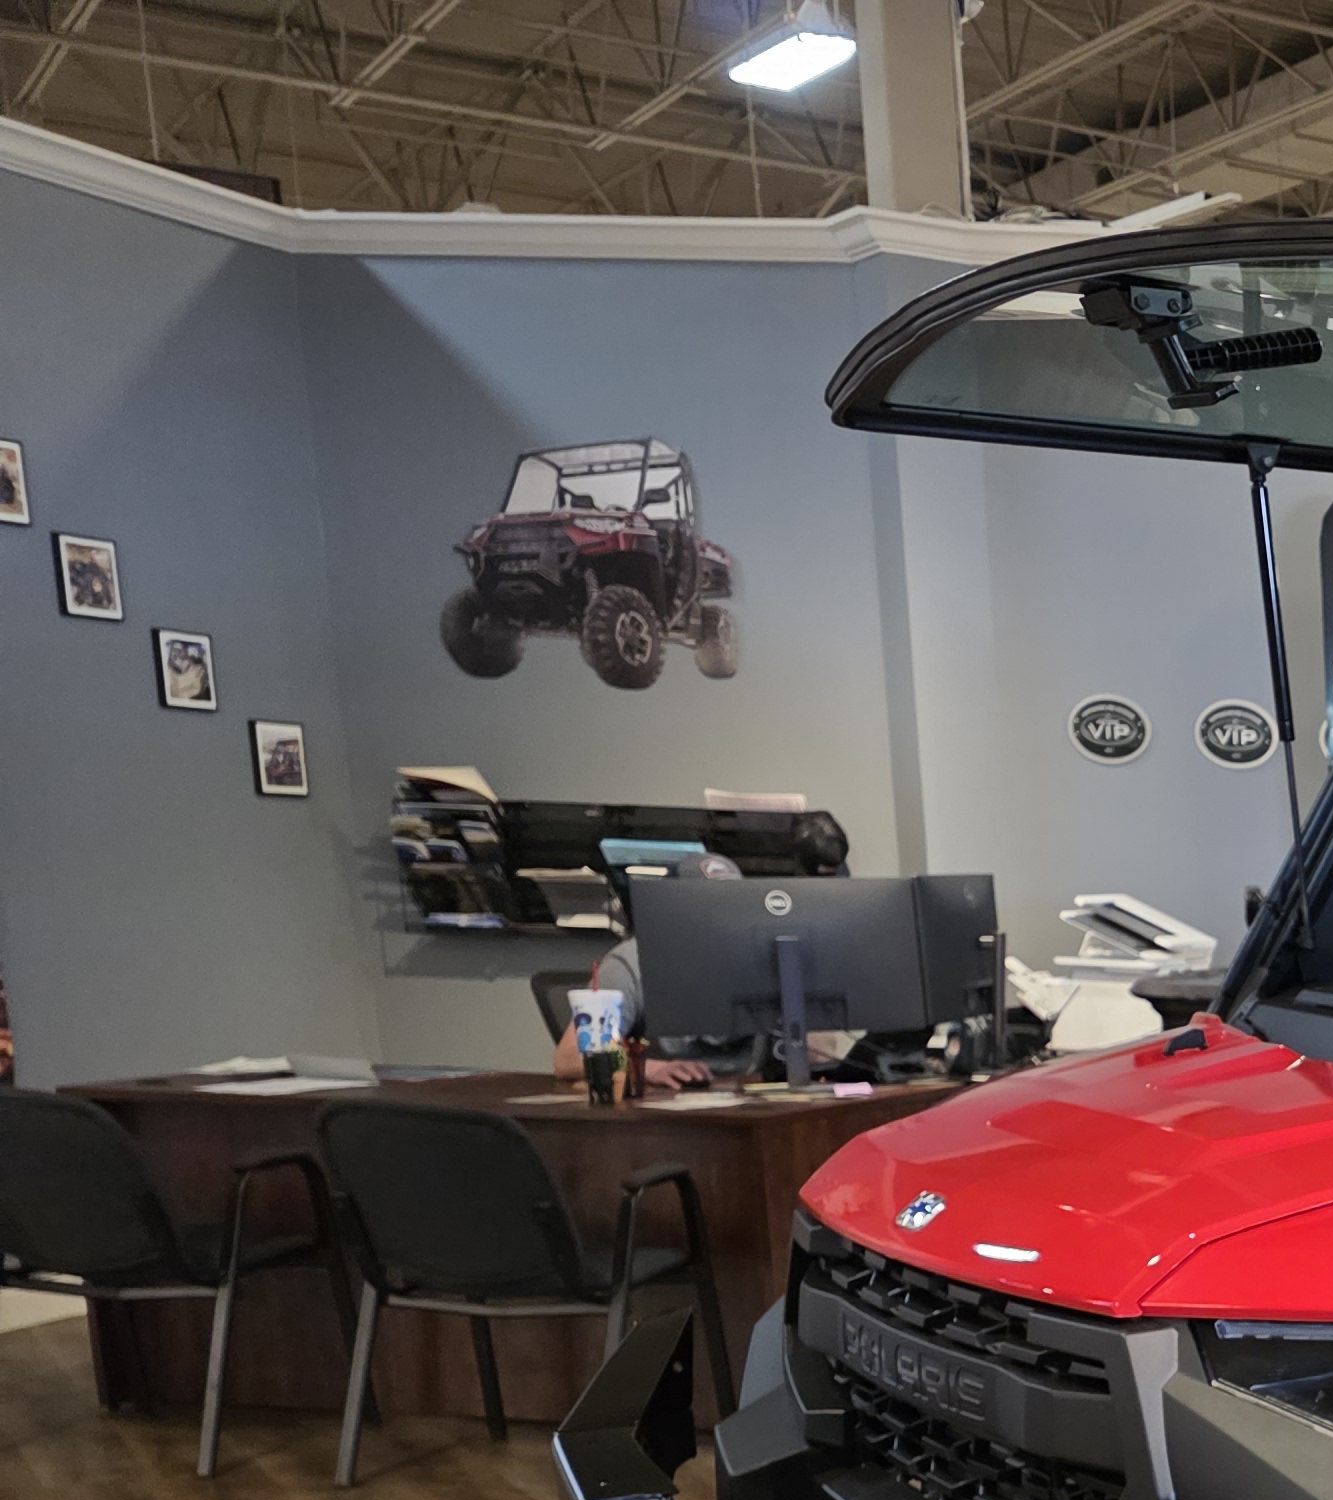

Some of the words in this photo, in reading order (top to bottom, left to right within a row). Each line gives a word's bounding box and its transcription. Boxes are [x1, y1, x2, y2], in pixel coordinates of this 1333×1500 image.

[1087, 720, 1131, 741] VIP
[1214, 726, 1259, 746] VIP
[841, 1309, 986, 1422] POLARIS
